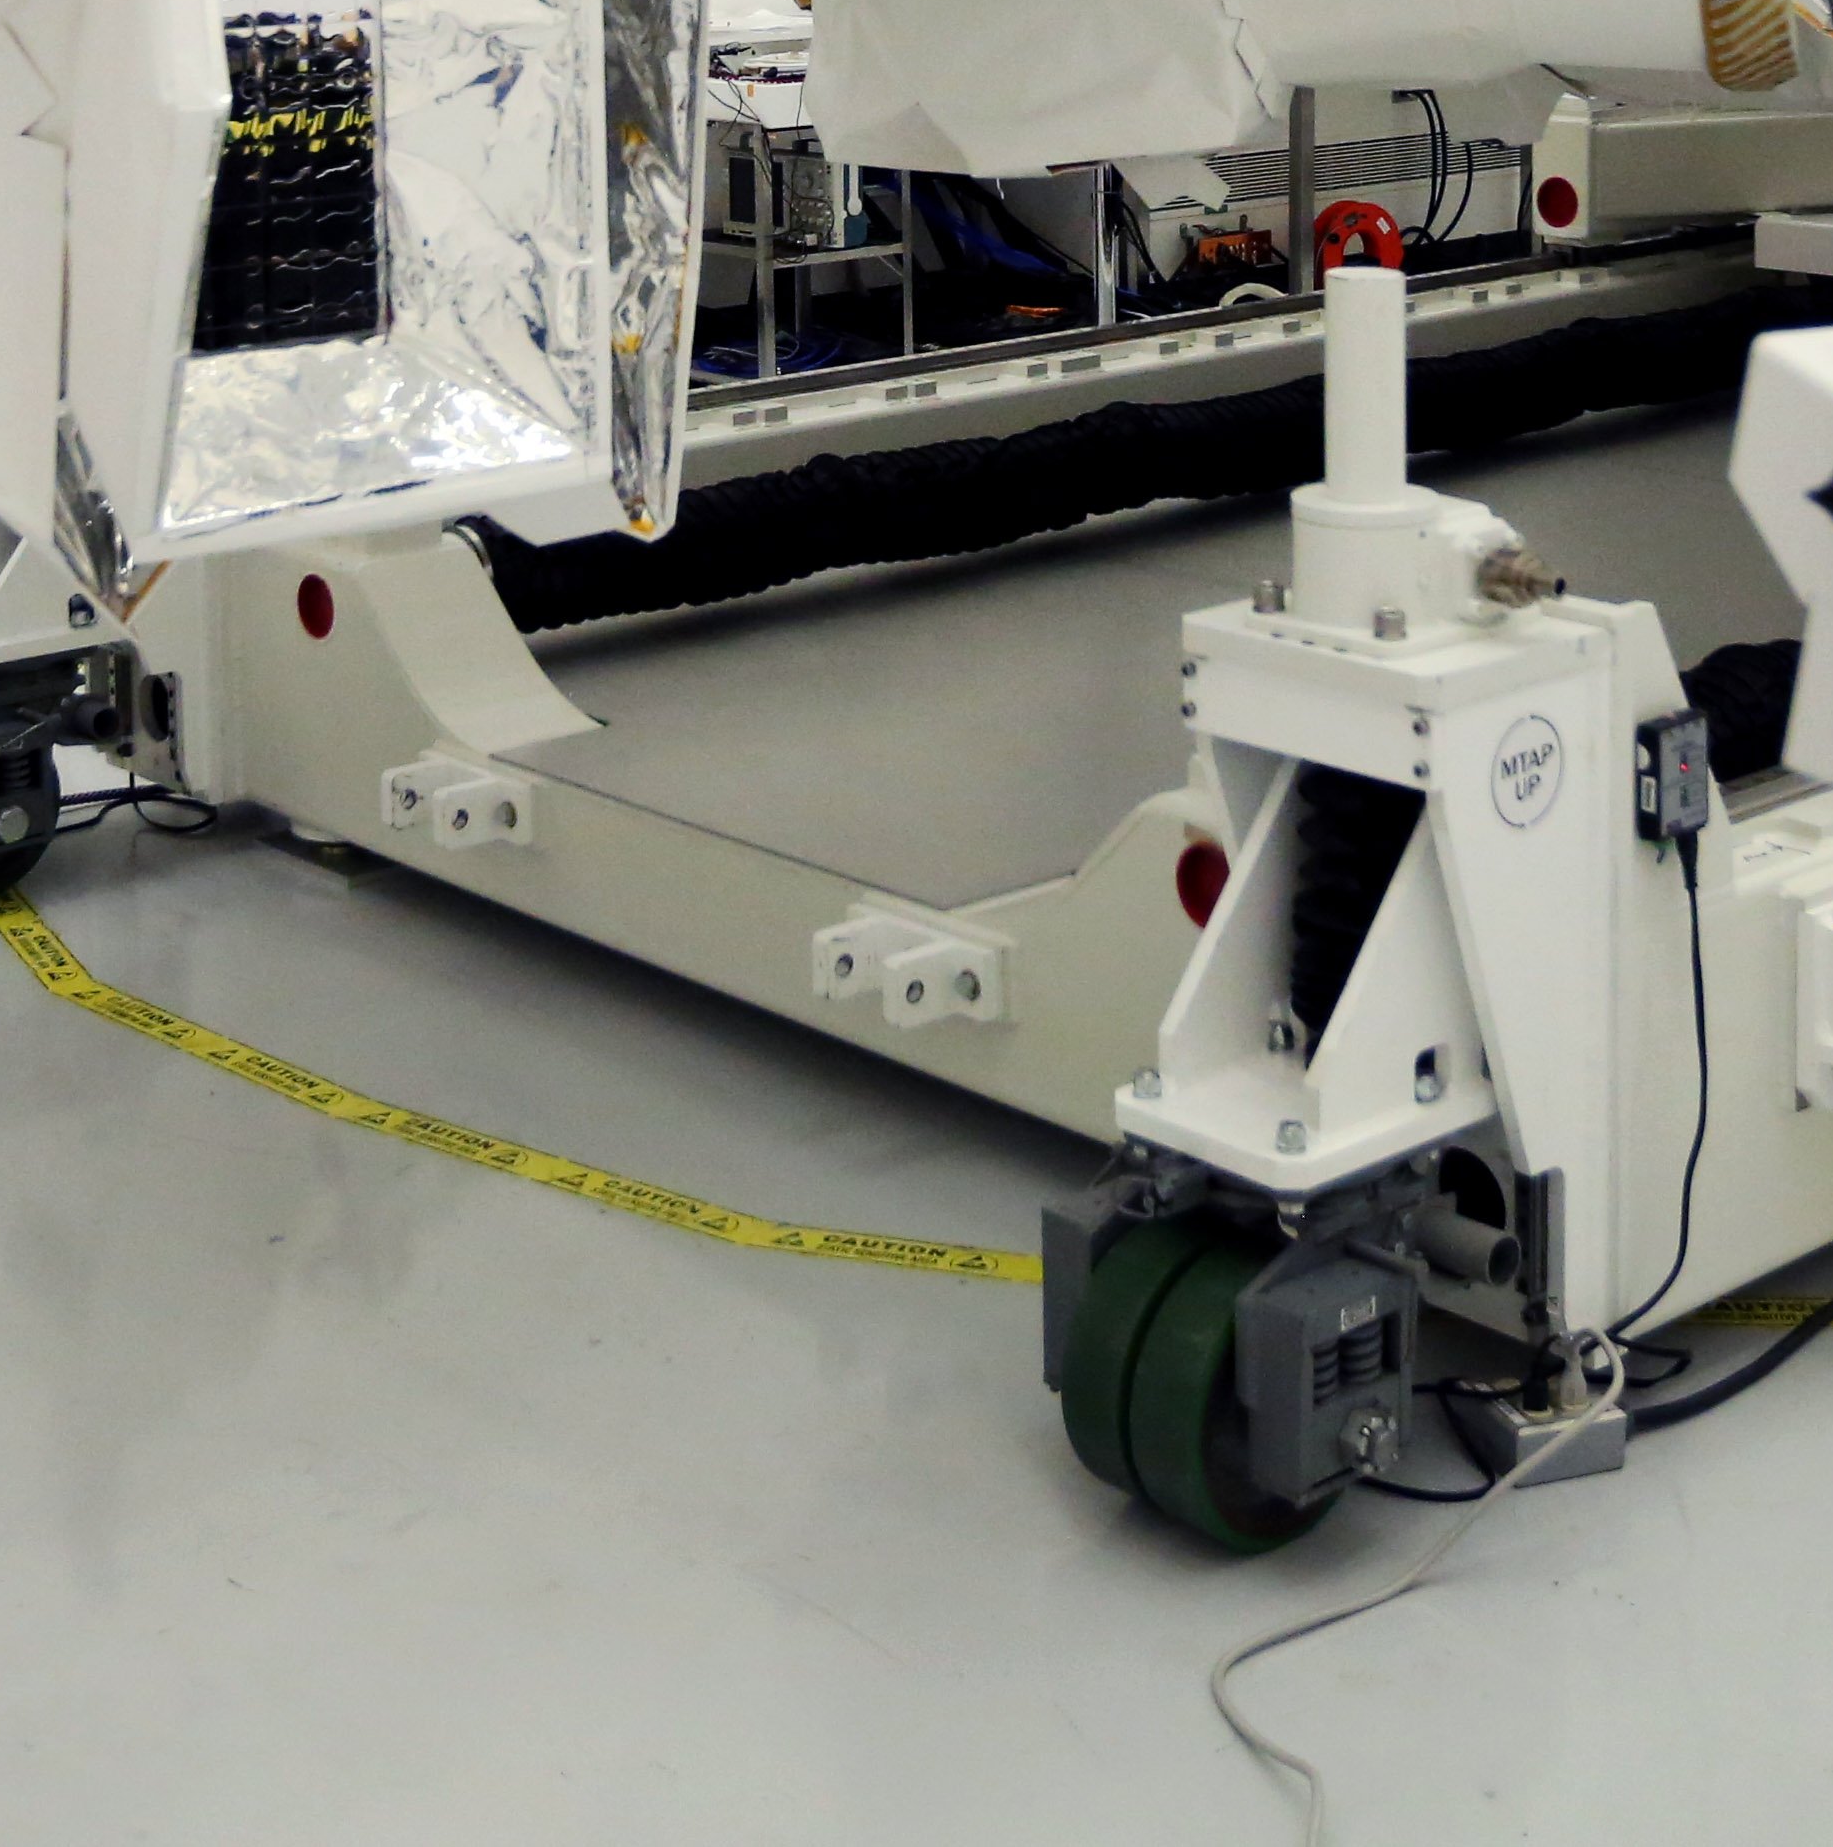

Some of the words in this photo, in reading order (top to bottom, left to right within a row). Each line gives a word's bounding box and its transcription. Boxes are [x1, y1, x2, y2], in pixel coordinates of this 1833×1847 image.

[1501, 743, 1553, 779] MTAP
[1516, 774, 1541, 801] UP
[246, 1055, 321, 1090] CAUTION
[406, 1116, 495, 1150] CAUTION
[823, 1234, 948, 1258] CAUTION
